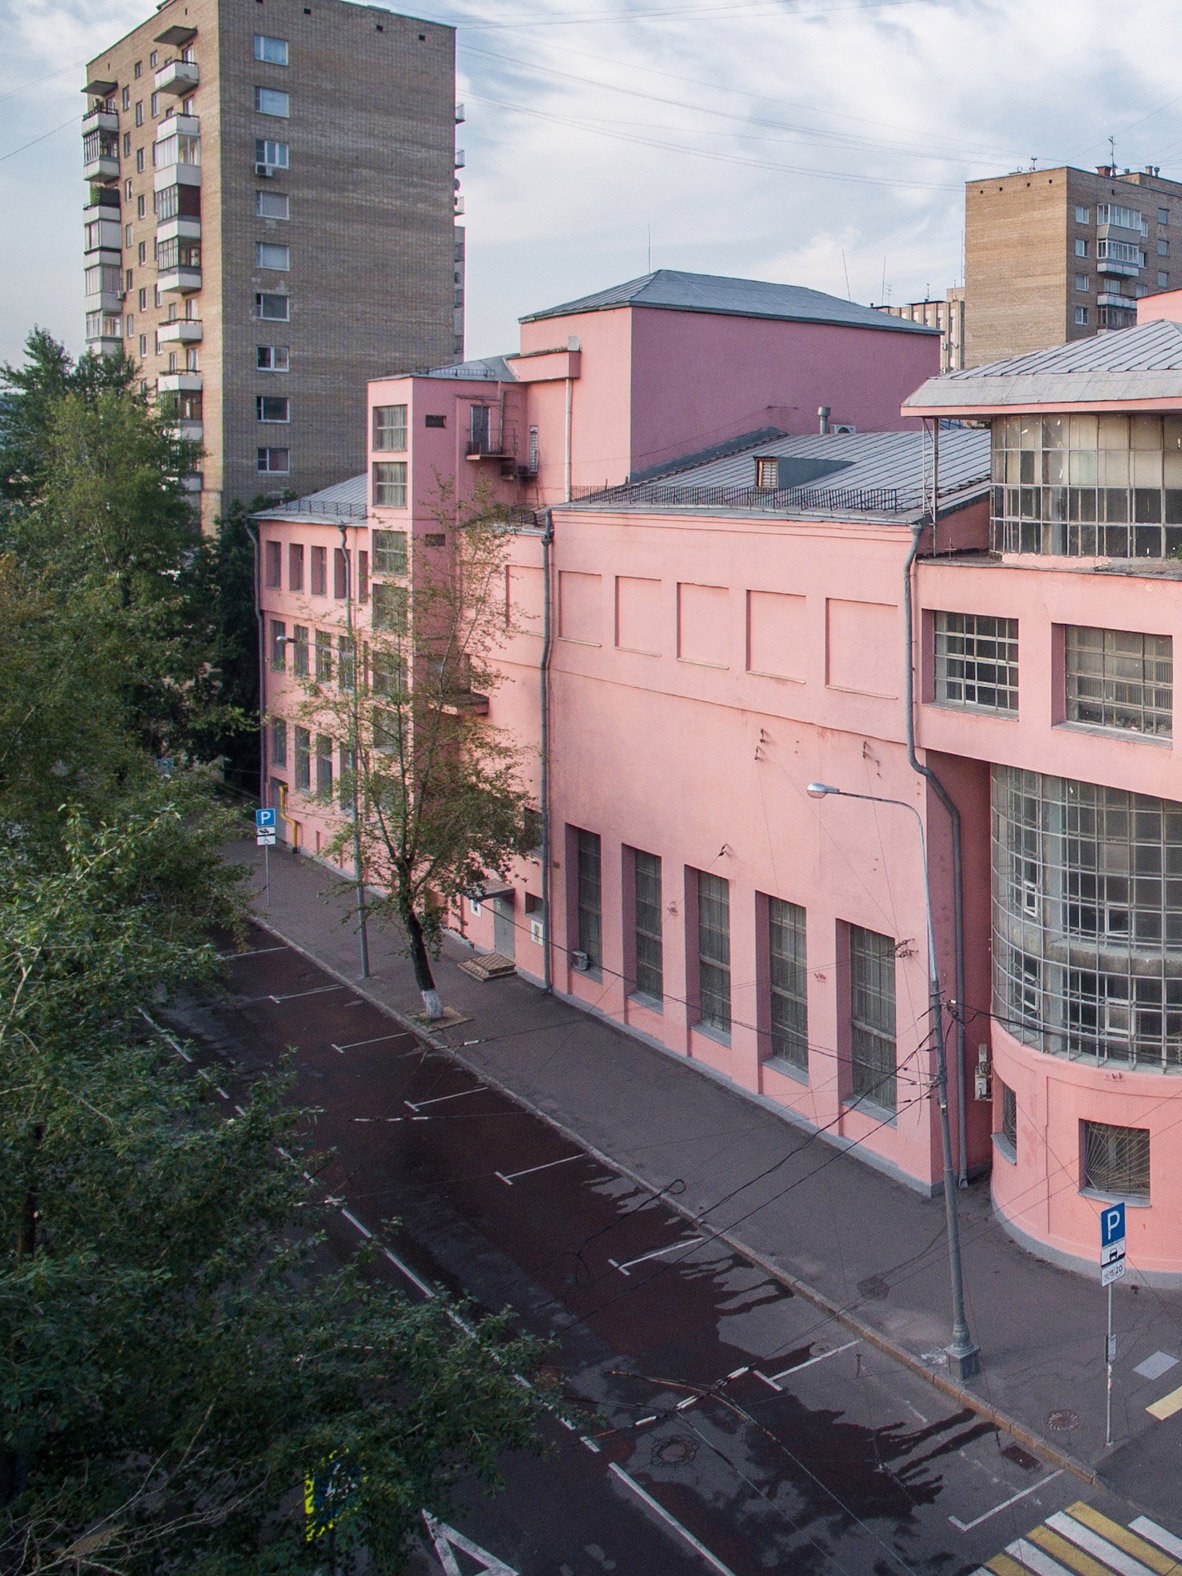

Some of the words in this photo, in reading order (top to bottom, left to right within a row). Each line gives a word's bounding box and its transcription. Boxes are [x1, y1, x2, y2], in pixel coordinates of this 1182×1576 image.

[260, 811, 271, 825] P
[1107, 1210, 1121, 1240] P
[1115, 1264, 1123, 1275] 20
